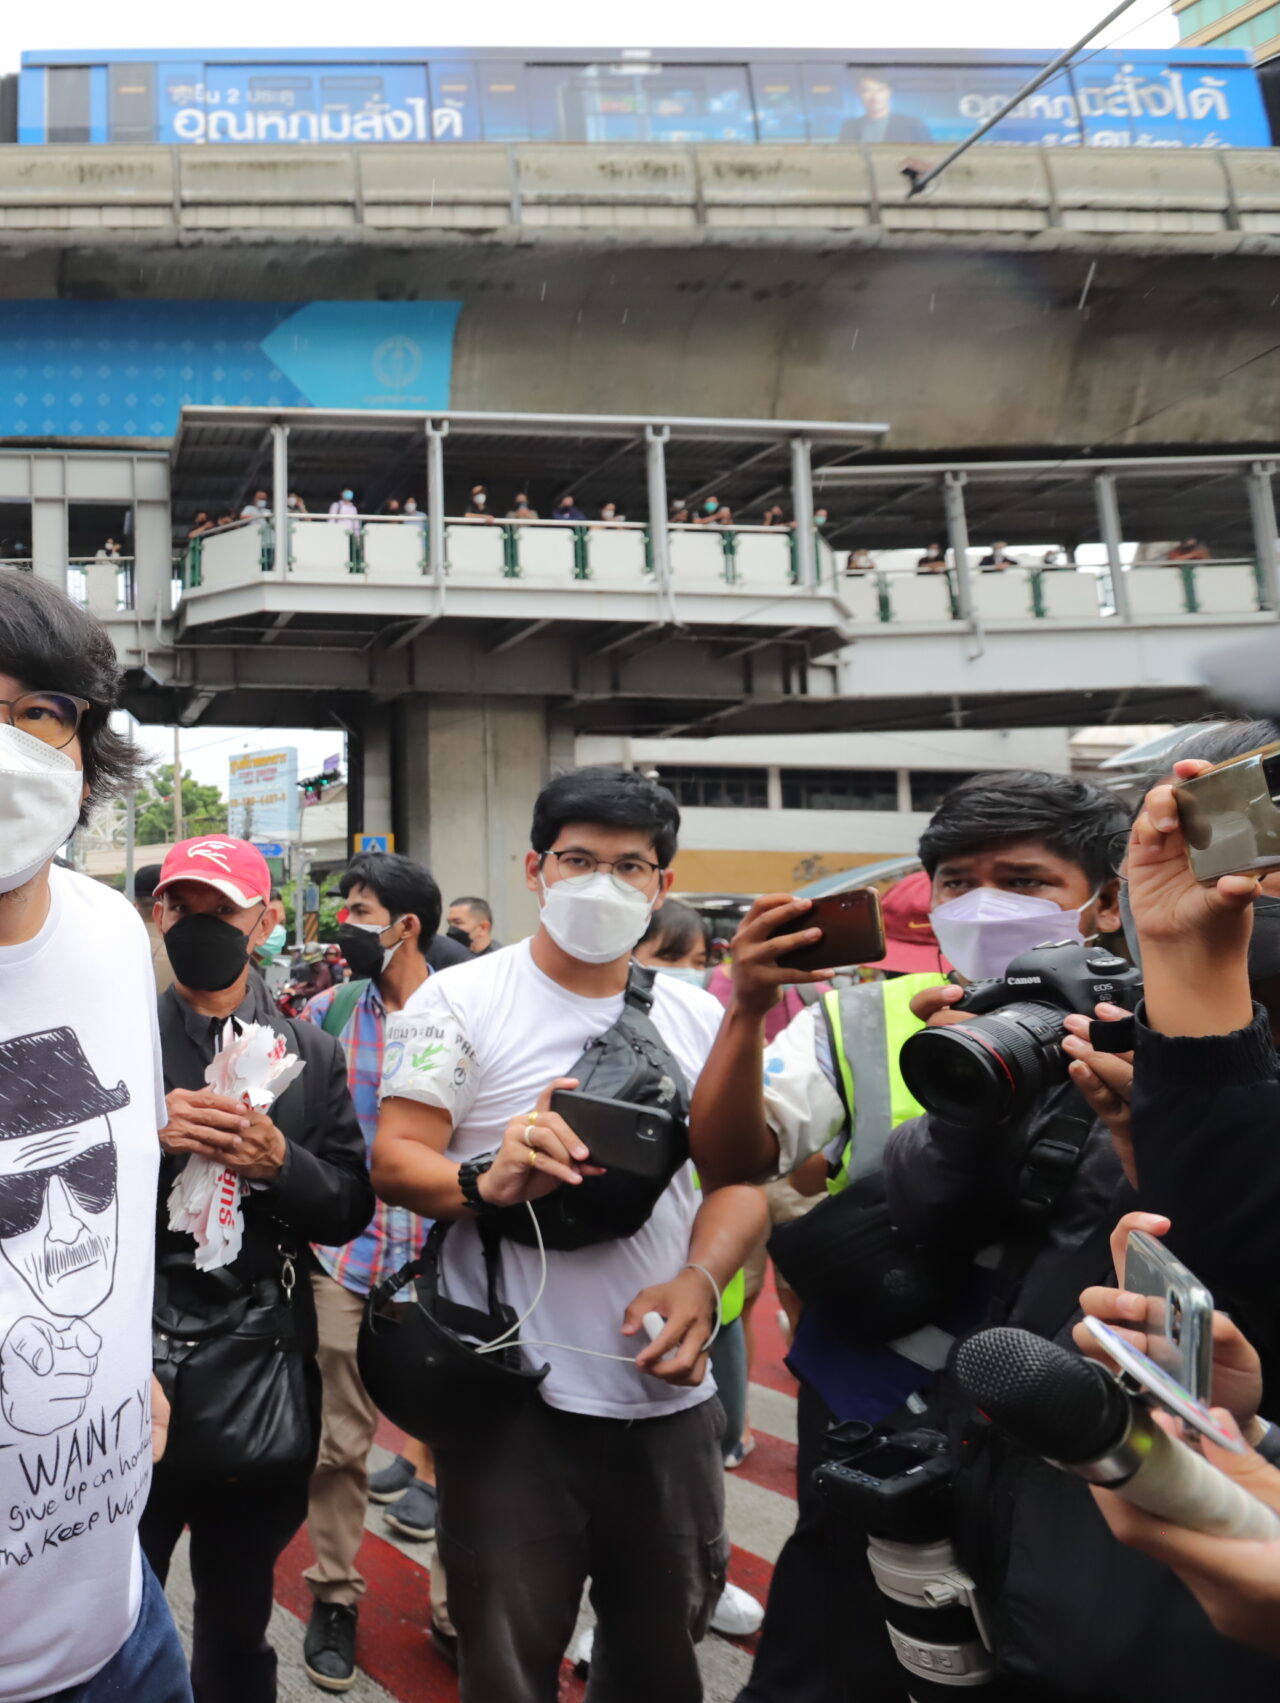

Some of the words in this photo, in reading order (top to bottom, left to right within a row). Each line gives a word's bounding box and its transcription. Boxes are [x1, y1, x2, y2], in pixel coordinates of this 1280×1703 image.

[227, 88, 240, 104] 2
[1007, 975, 1042, 987] Canon
[1093, 983, 1114, 993] EOS
[19, 1397, 133, 1496] WANT
[9, 1499, 61, 1532] give
[64, 1481, 88, 1506] up
[92, 1467, 114, 1488] on
